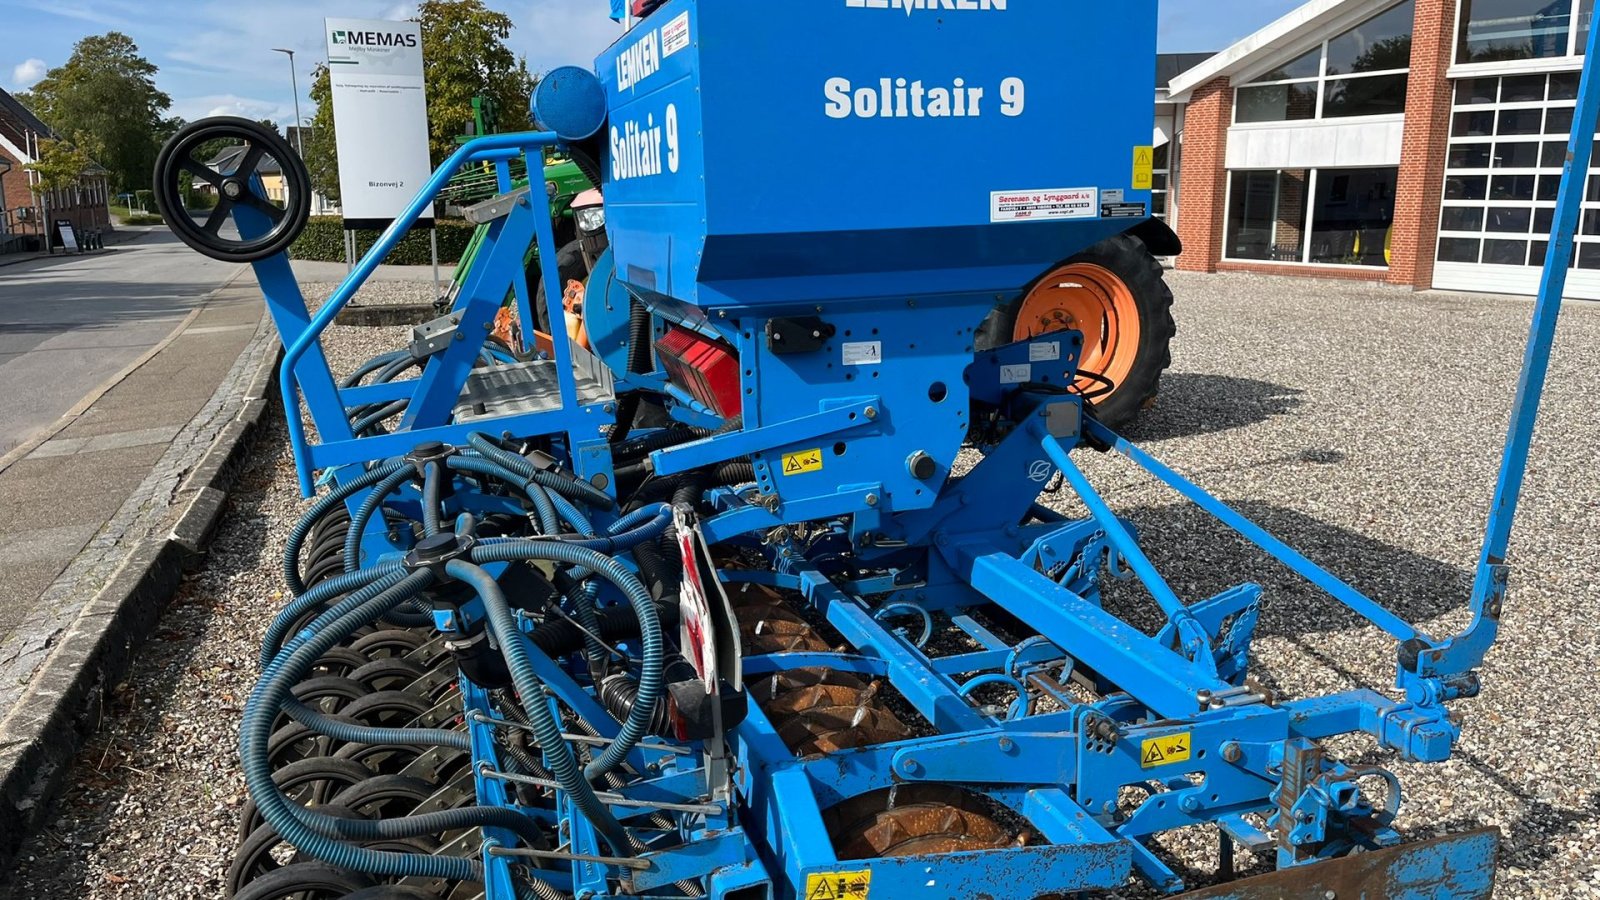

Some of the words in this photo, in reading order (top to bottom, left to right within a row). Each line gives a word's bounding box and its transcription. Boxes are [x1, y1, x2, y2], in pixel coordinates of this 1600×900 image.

[348, 31, 417, 47] MEMAS
[616, 28, 660, 95] LEMKEN
[824, 76, 984, 119] Solitair
[999, 76, 1025, 117] 9
[610, 112, 662, 181] Solitair
[665, 103, 679, 174] 9
